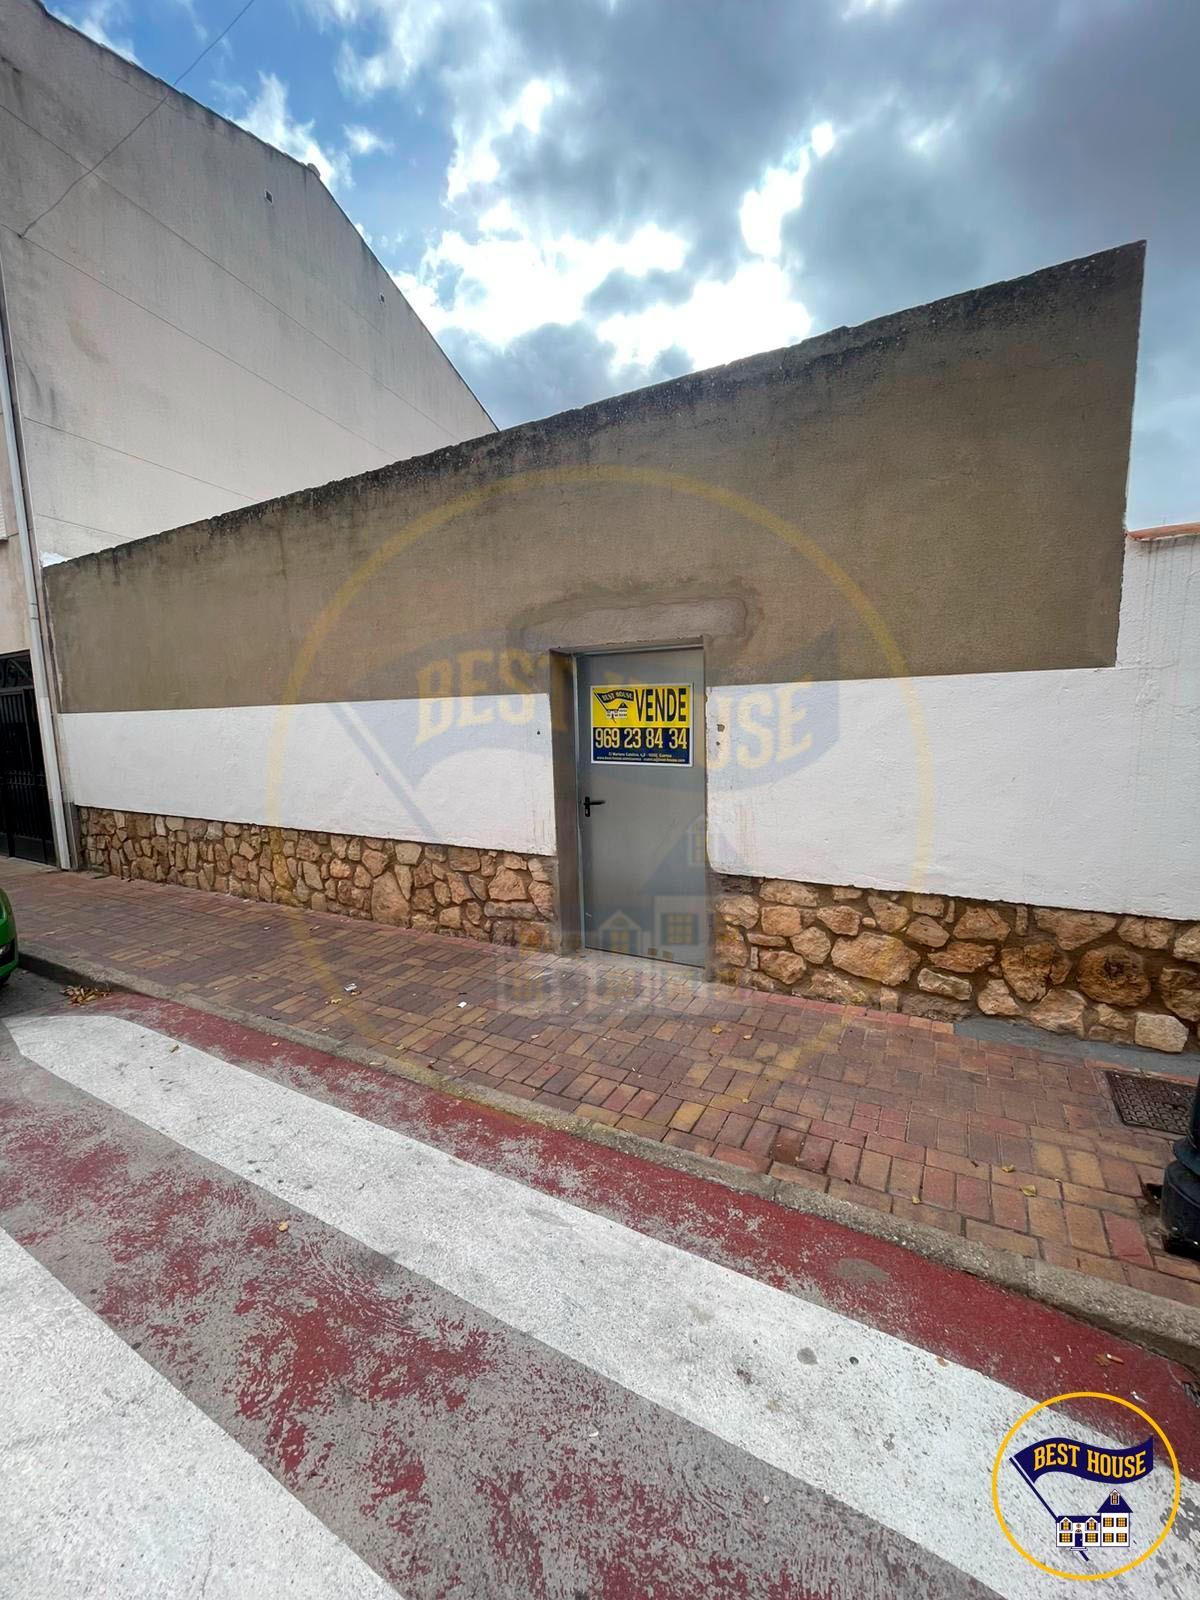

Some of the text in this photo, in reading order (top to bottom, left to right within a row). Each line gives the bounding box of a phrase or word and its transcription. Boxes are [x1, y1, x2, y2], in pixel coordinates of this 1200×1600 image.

[635, 688, 687, 722] VENDE
[595, 728, 687, 749] 969 23 84 34
